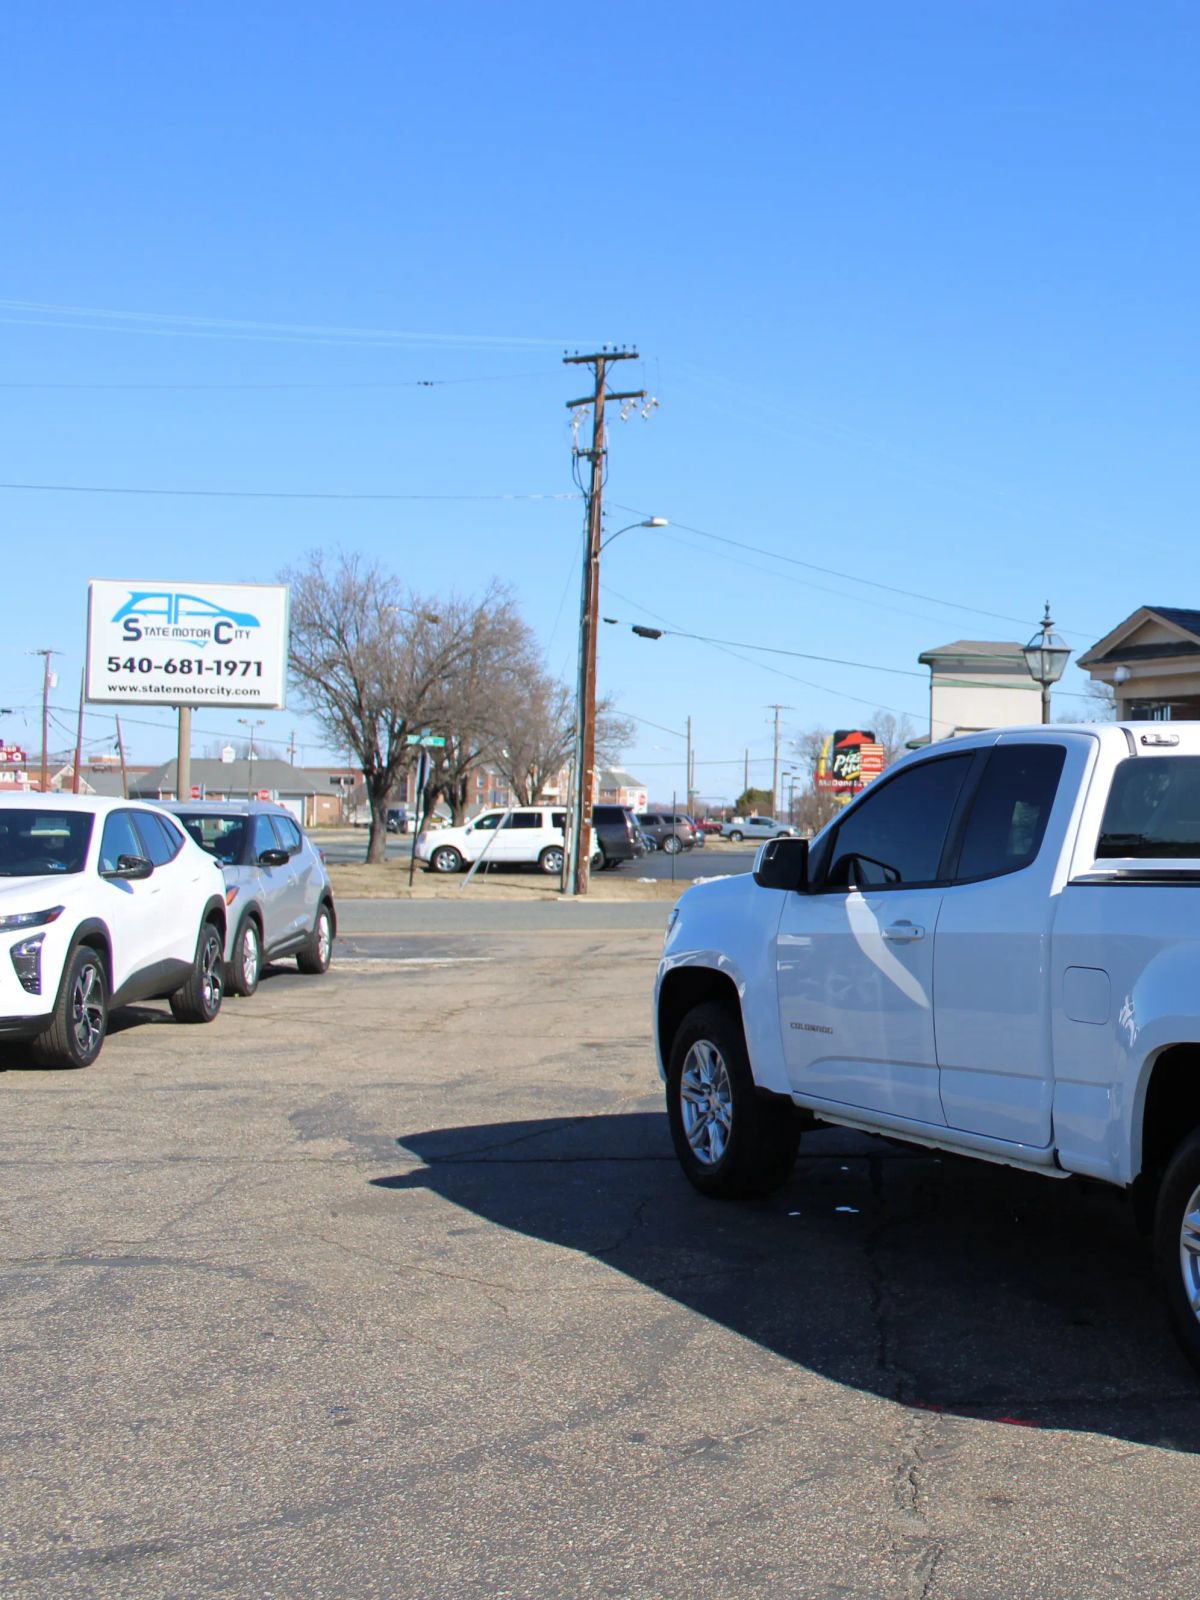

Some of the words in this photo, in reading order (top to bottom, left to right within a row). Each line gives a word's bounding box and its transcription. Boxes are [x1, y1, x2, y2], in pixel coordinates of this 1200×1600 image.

[122, 618, 169, 642] STATE
[172, 626, 211, 639] MOTOR
[214, 622, 251, 645] CITY
[107, 656, 262, 677] 540-681-1971
[108, 684, 260, 697] www.statemotorcity.com
